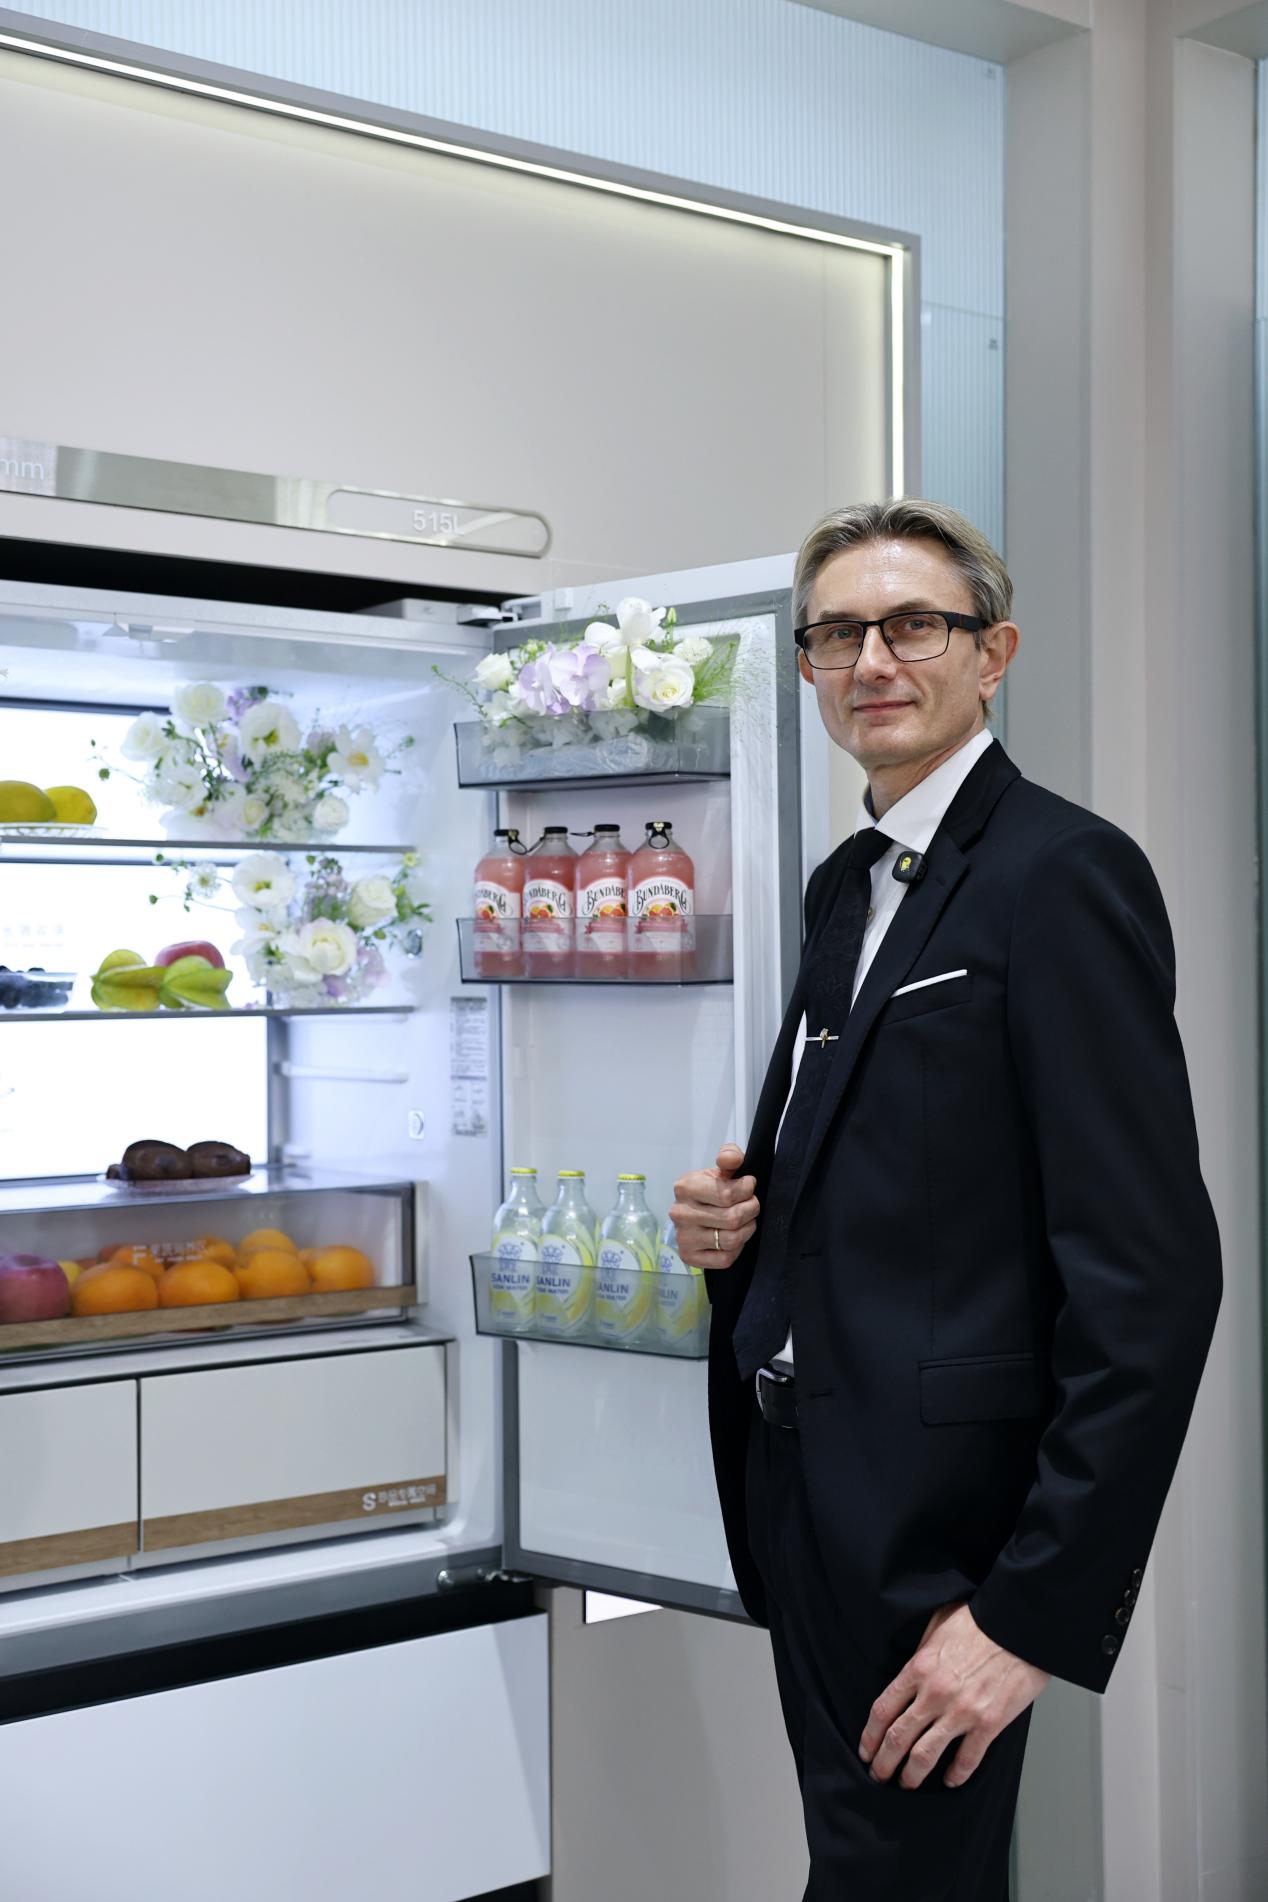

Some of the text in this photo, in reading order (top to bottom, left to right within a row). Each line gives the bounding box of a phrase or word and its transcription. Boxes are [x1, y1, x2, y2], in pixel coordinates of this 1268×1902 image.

[414, 510, 465, 535] 515L
[633, 884, 689, 914] BUNDABERG
[491, 1272, 530, 1284] SANLIN
[362, 1492, 377, 1512] S
